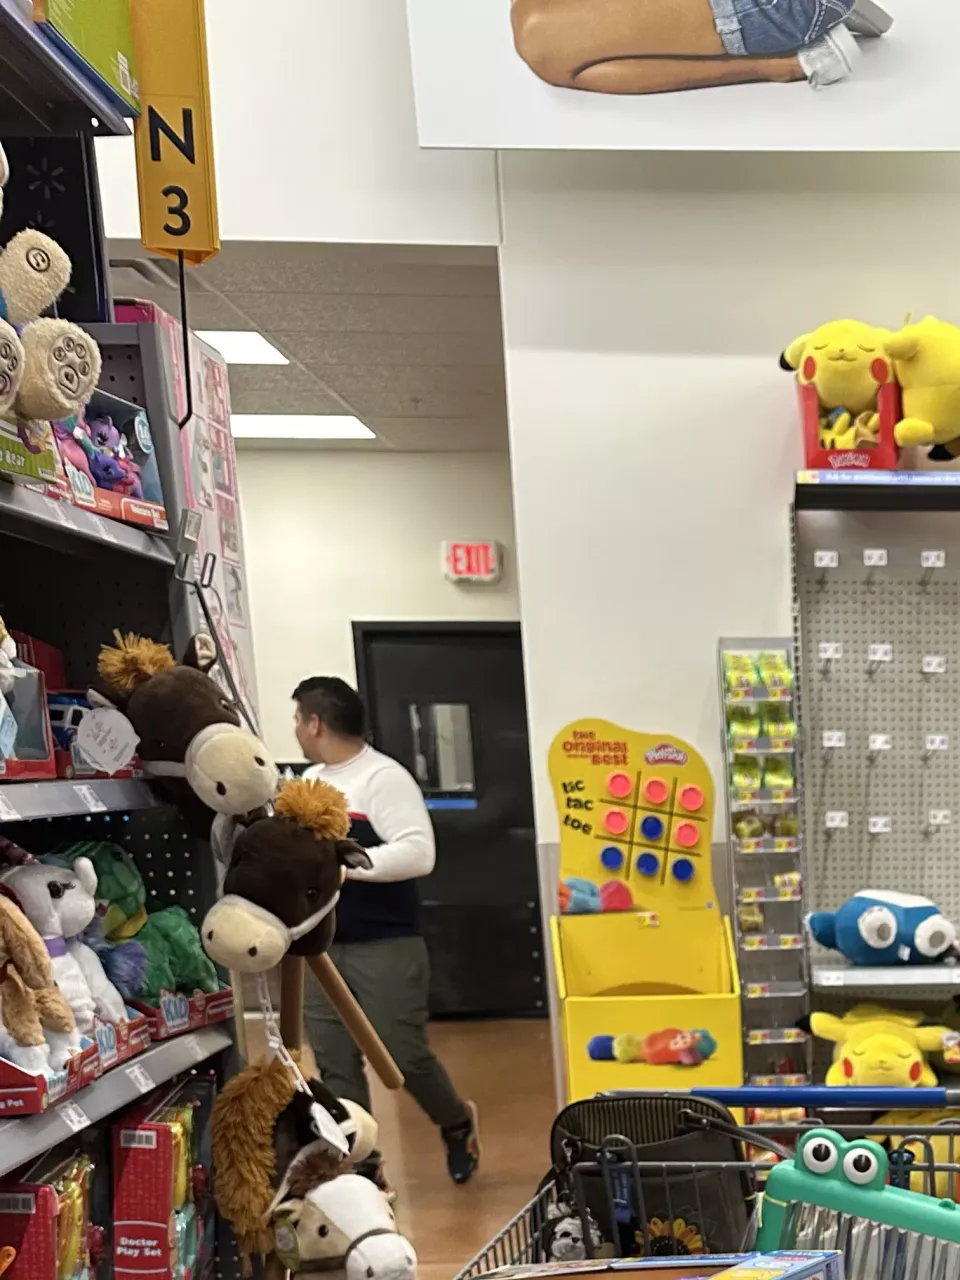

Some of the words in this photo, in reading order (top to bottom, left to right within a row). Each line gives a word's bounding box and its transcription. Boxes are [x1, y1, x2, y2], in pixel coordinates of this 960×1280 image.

[147, 106, 196, 164] N
[161, 185, 192, 236] 3
[451, 543, 491, 576] EXIT
[561, 780, 586, 794] tic
[566, 797, 594, 811] tac
[563, 814, 593, 835] toe
[163, 994, 189, 1023] KID
[116, 1246, 141, 1258] Play
[143, 1247, 162, 1256] Set
[119, 1236, 159, 1247] Doctor
